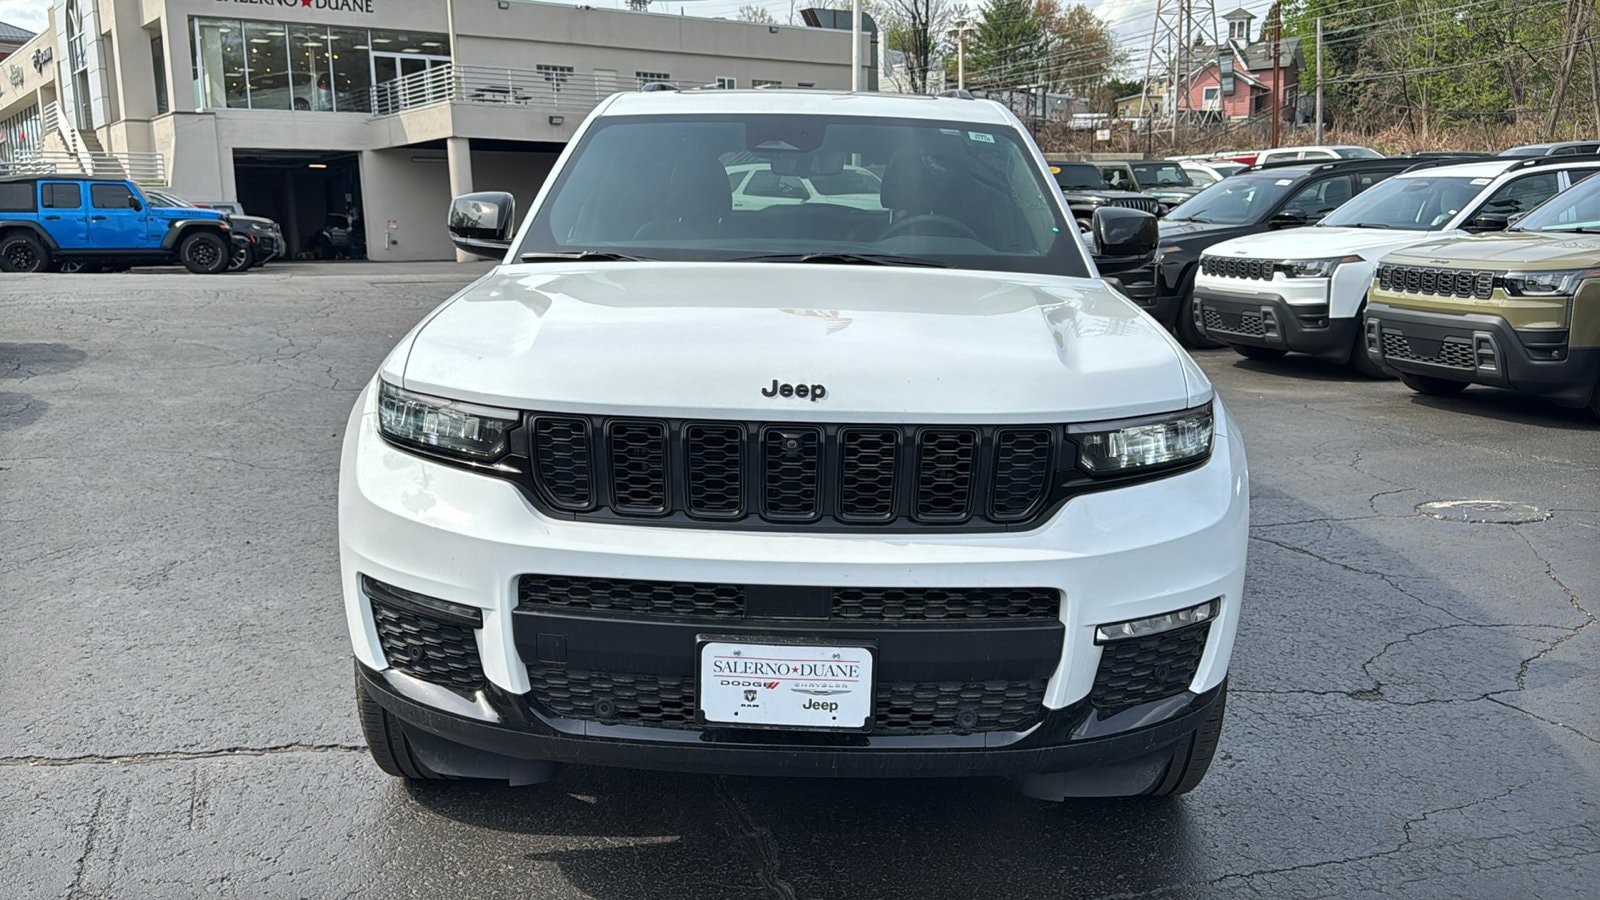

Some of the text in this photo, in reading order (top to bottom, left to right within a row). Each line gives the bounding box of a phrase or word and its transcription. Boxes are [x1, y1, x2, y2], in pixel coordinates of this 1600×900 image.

[315, 0, 374, 13] DUANE
[761, 379, 826, 402] Jeep
[713, 660, 860, 678] SALERNO DUANE
[802, 698, 839, 713] Jeep
